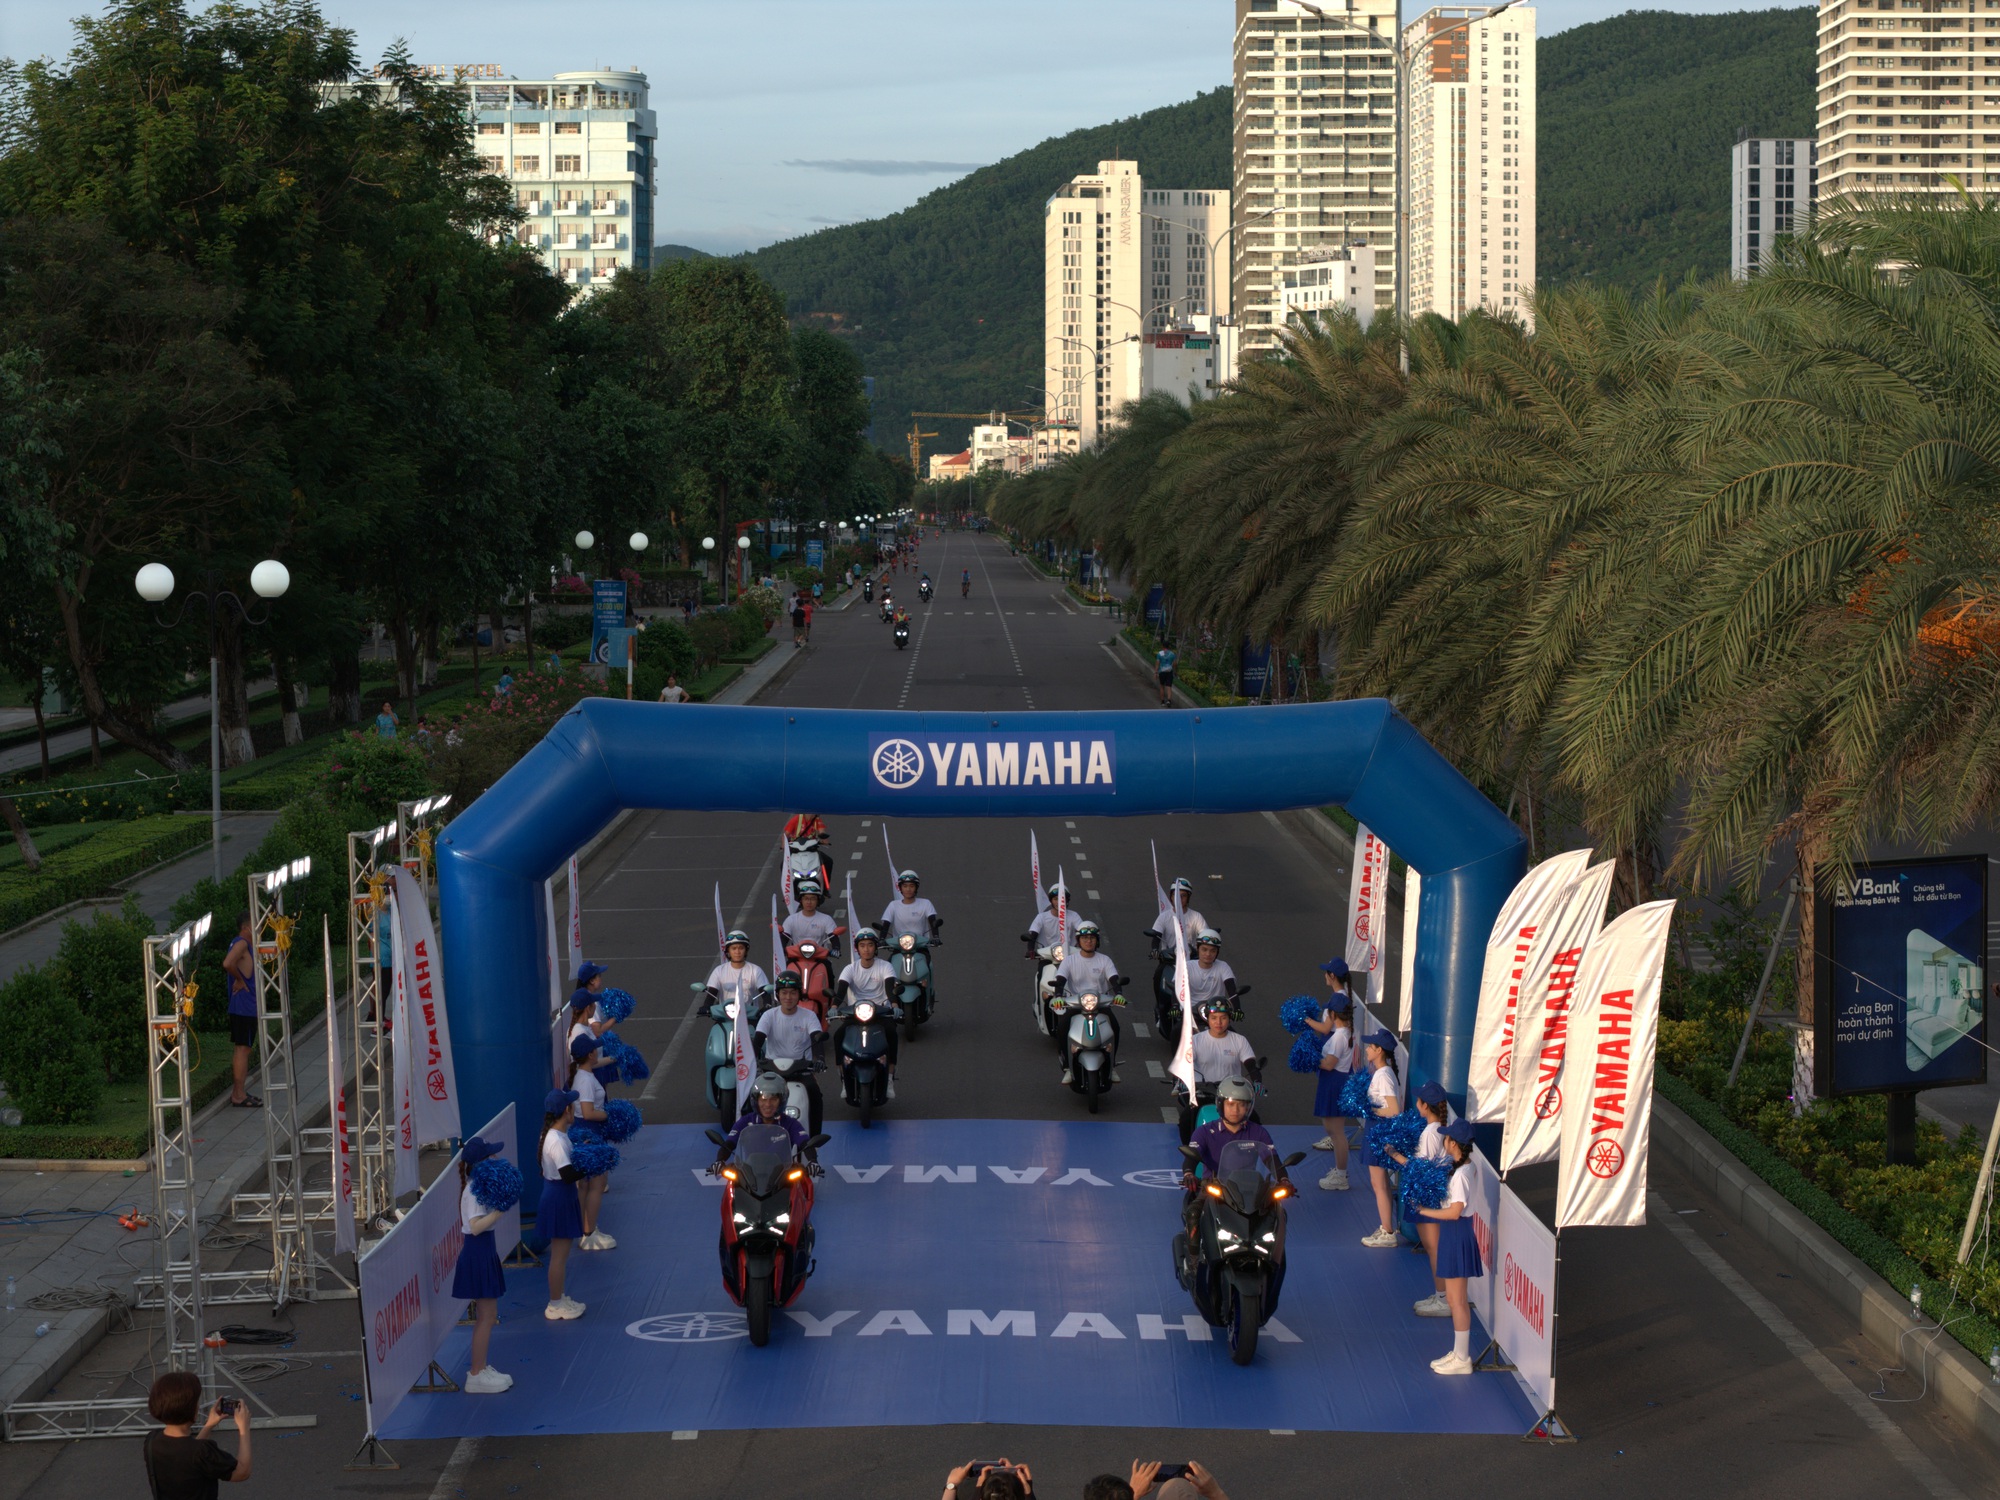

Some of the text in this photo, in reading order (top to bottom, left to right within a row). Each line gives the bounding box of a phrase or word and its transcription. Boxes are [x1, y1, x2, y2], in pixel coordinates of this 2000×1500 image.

[1120, 177, 1131, 218] PREMIER
[928, 741, 1113, 786] YAMAHA
[1855, 897, 1872, 906] hàng
[1873, 896, 1885, 904] Bản
[1886, 895, 1900, 904] Việt
[1538, 946, 1582, 1084] YAMAHA
[1837, 1015, 1894, 1028] hoàn thành
[1874, 1002, 1893, 1014] Bạn
[1837, 1028, 1893, 1043] mọi dự định
[1591, 989, 1634, 1135] YAMAHA
[384, 1274, 421, 1349] YAMAHA
[1514, 1262, 1545, 1340] YAMAHA
